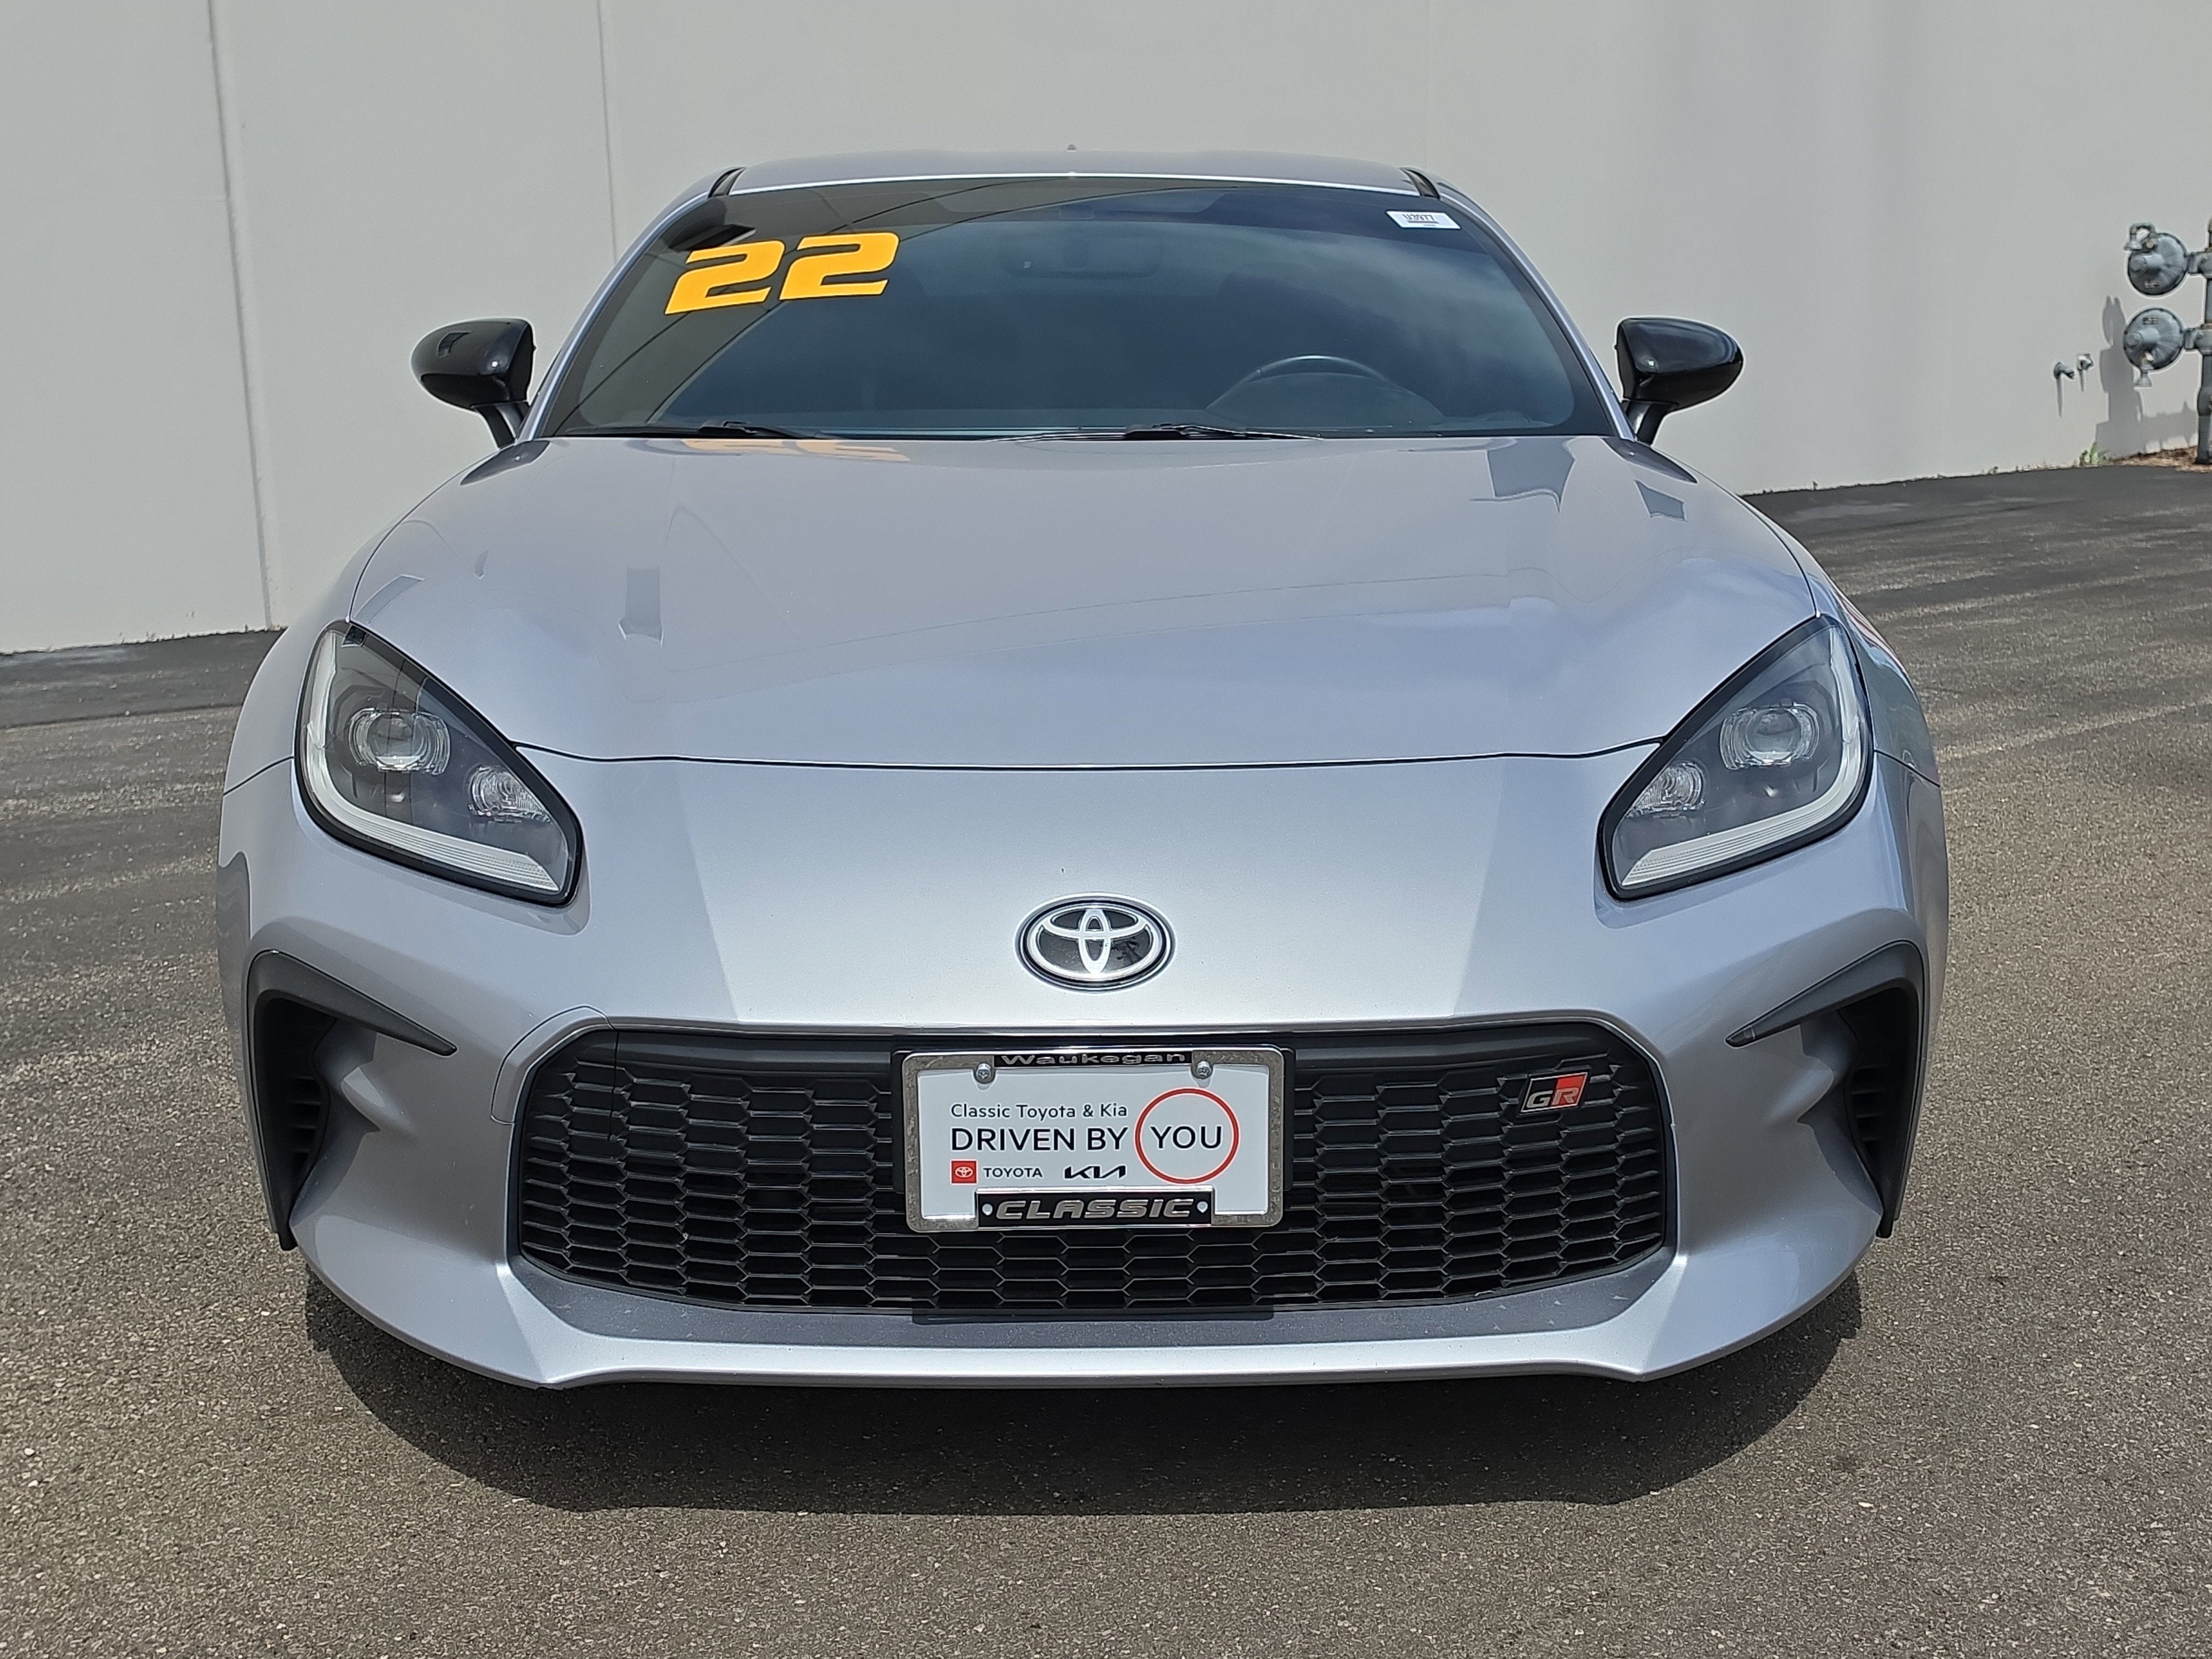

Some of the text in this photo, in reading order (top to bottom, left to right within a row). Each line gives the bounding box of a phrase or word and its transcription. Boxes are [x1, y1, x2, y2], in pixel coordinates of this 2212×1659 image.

[664, 232, 900, 314] 22
[1001, 1053, 1186, 1065] Waukegan
[1526, 1087, 1579, 1108] GR
[951, 1103, 1127, 1121] Classic Toyota & Kia
[951, 1126, 1222, 1151] DRIVEN BY YOU
[983, 1167, 1043, 1178] TOYOTA
[996, 1199, 1194, 1219] CLASSIC
